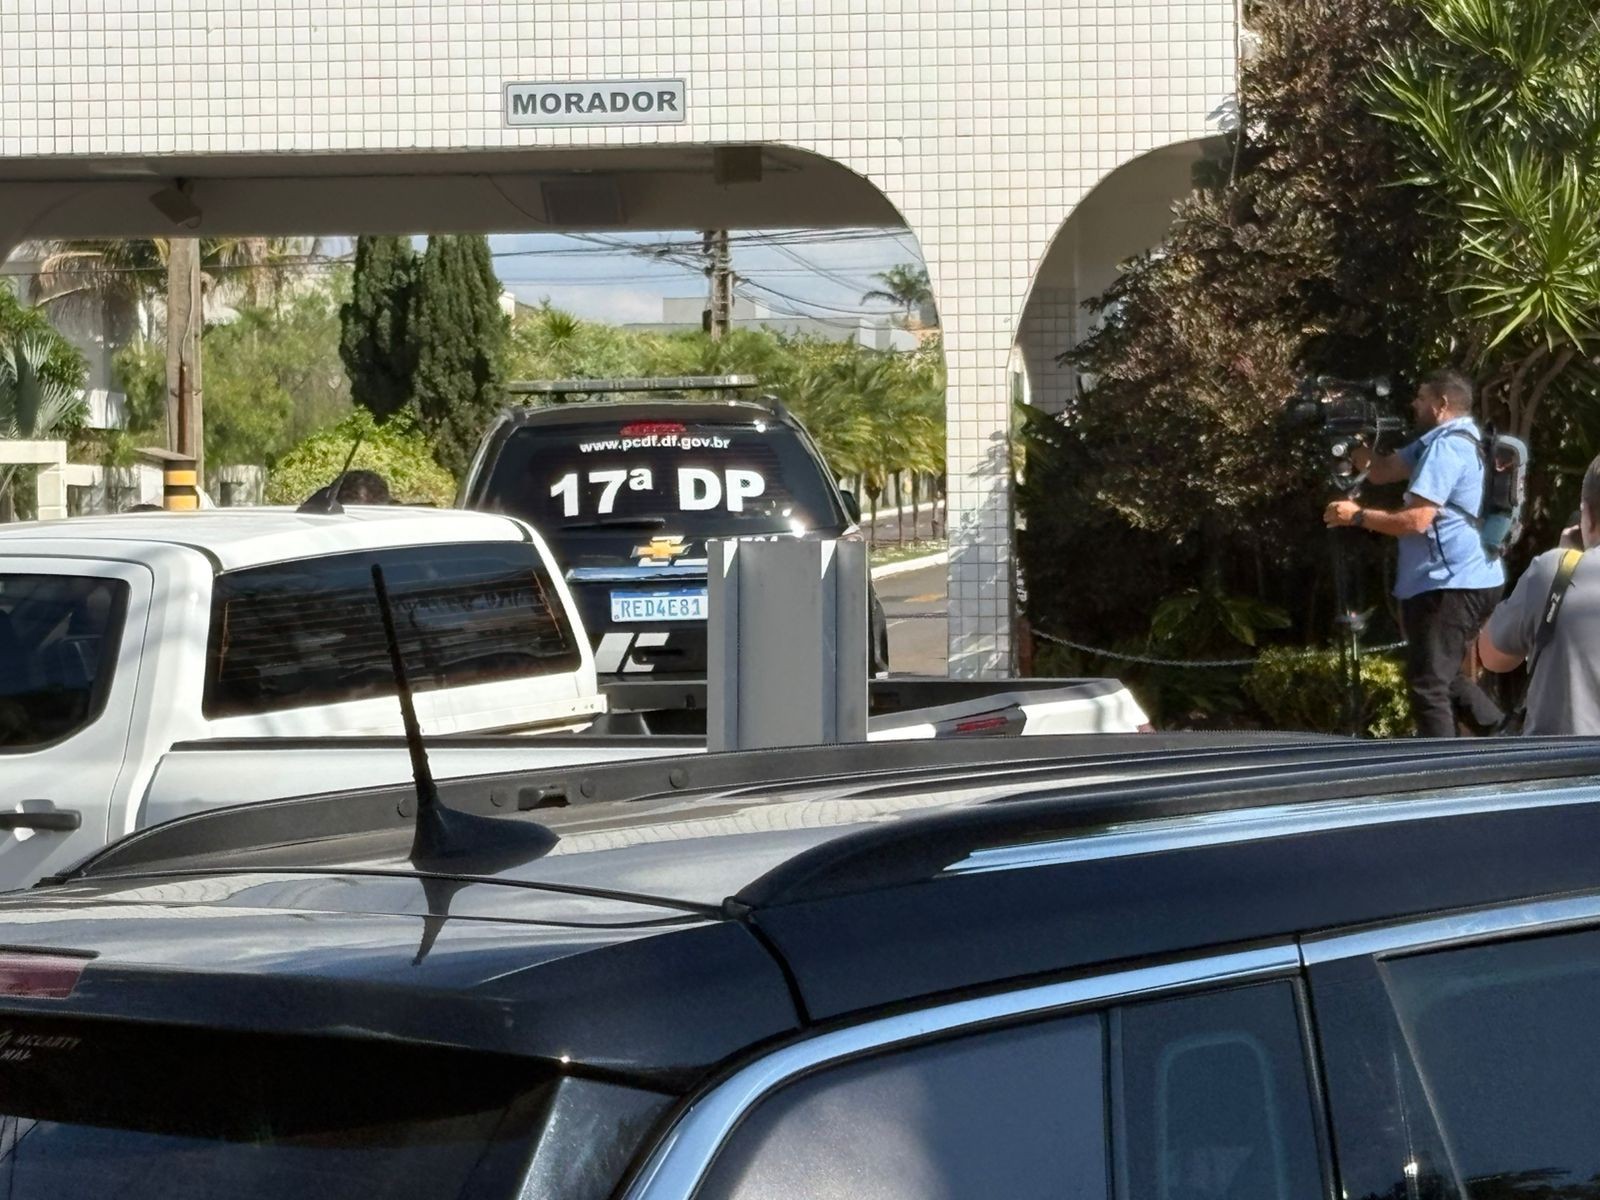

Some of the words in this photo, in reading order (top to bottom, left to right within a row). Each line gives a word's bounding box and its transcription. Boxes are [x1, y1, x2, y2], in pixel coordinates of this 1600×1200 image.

[512, 91, 678, 115] MORADOR
[579, 435, 731, 453] www.pcdf.df.gov.br
[677, 468, 765, 512] DP
[621, 598, 701, 618] RED4E81
